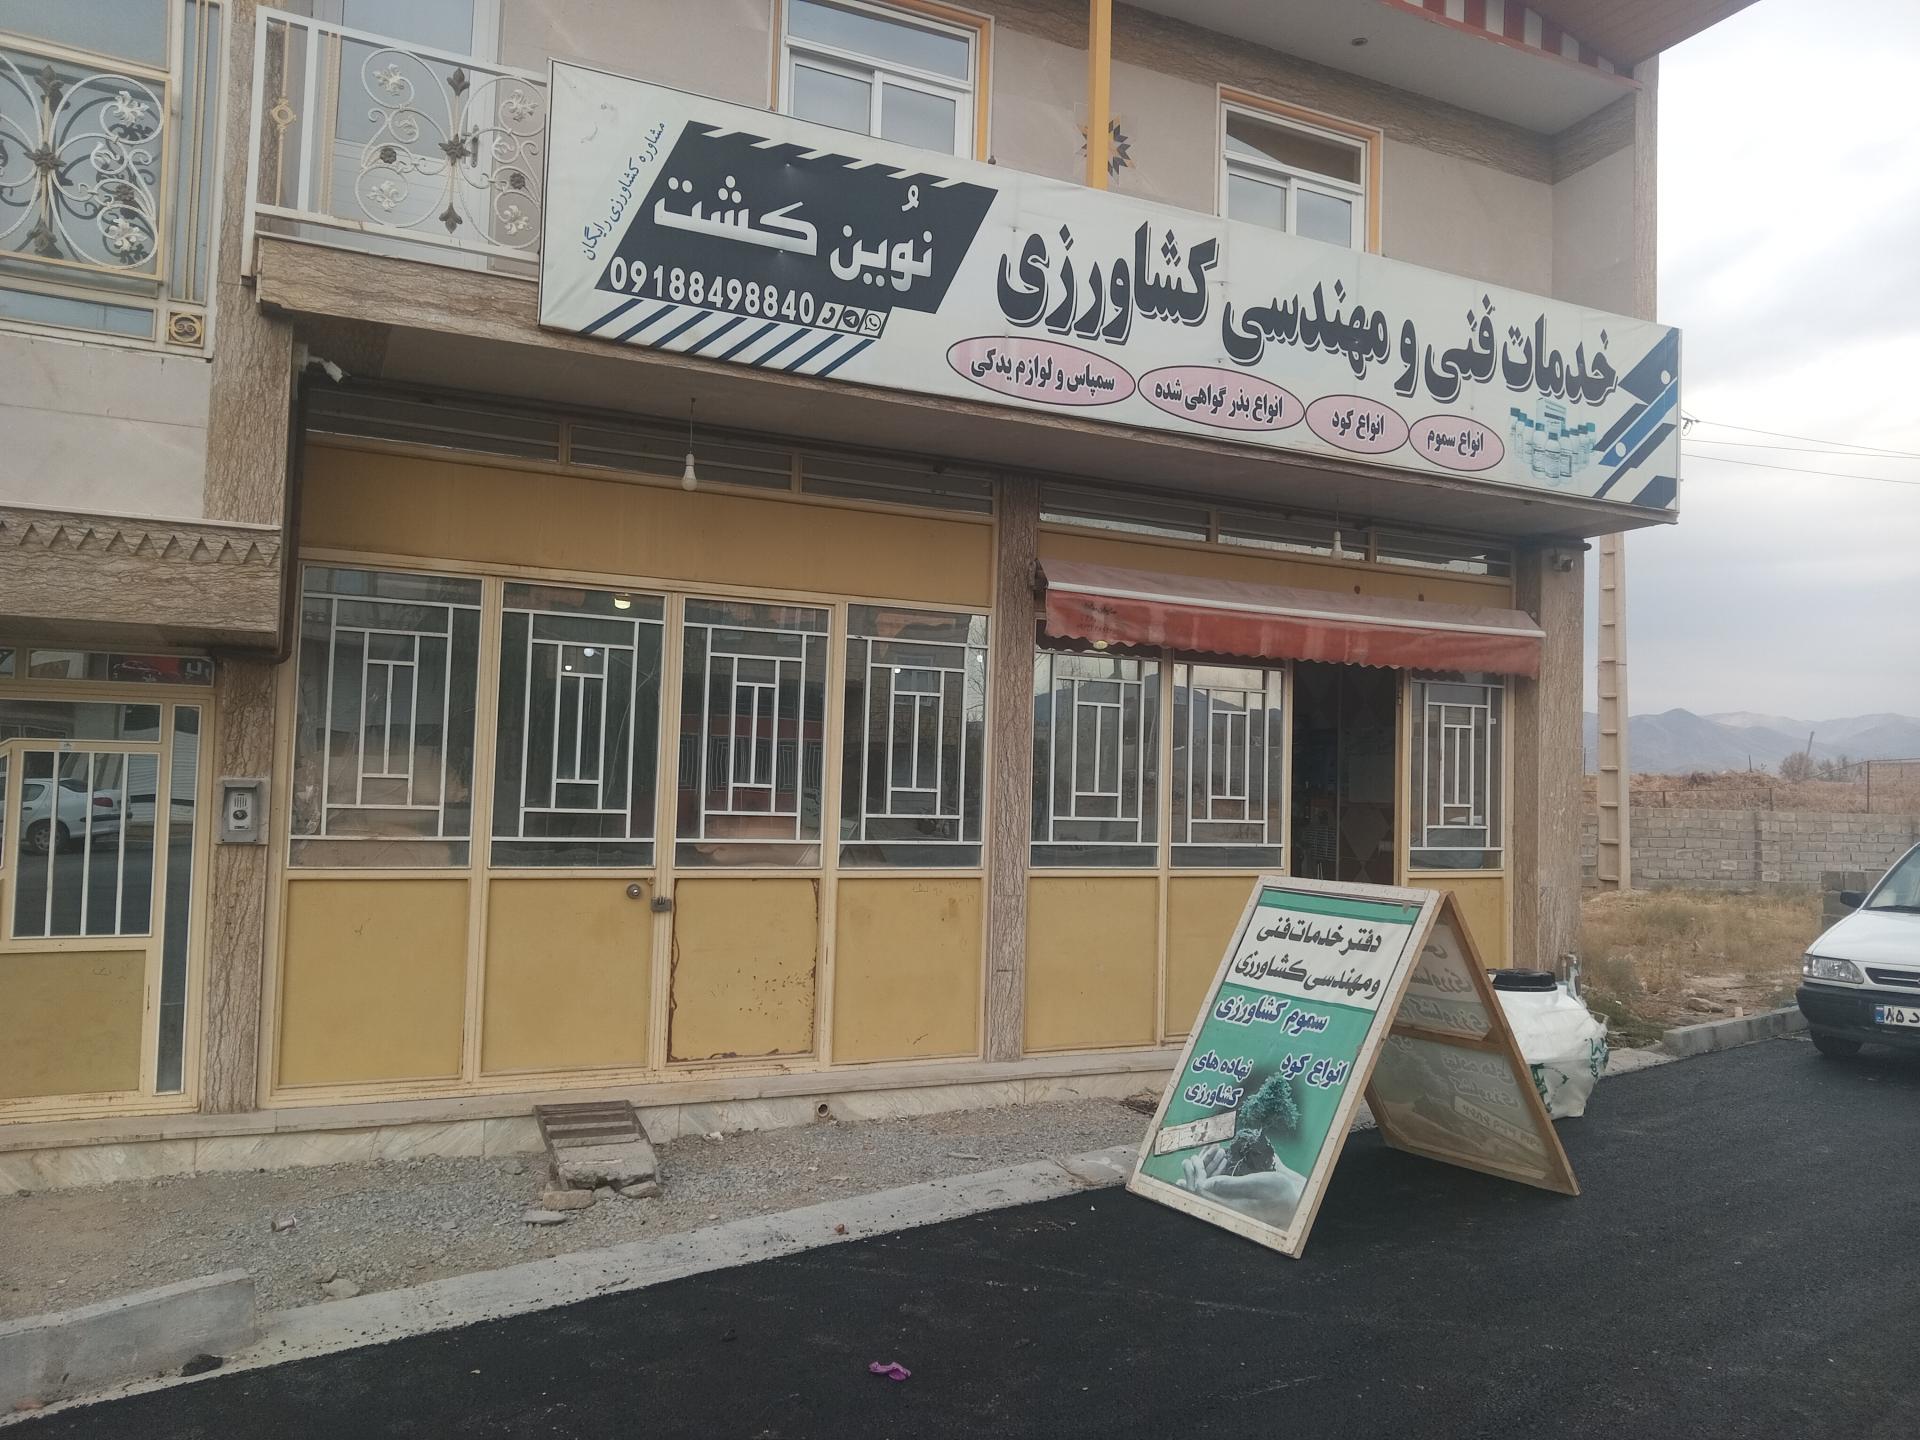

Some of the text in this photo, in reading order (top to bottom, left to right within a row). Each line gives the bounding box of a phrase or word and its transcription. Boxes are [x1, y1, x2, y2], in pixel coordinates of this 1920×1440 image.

[581, 122, 665, 261] مشاوره کشاورزی رایگان
[653, 175, 819, 257] کشت
[609, 255, 815, 324] 09188498840
[996, 220, 1619, 407] خدمات فنی و مهندسی کشاورزی
[970, 348, 1115, 397] سمپاس و لوازم یدکی
[1154, 379, 1283, 424] انواع بذر گواهی شده
[1356, 412, 1385, 442] انواع
[1427, 429, 1484, 458] انواع سموم
[1256, 916, 1382, 956] دفتر خدمات فنی
[1234, 950, 1308, 983] کشاورزی
[1216, 997, 1328, 1035] سموم کشاورزی
[1192, 1051, 1252, 1081] نهاده های
[1281, 1054, 1348, 1088] انواع کود
[1185, 1083, 1242, 1107] کشاورزی
